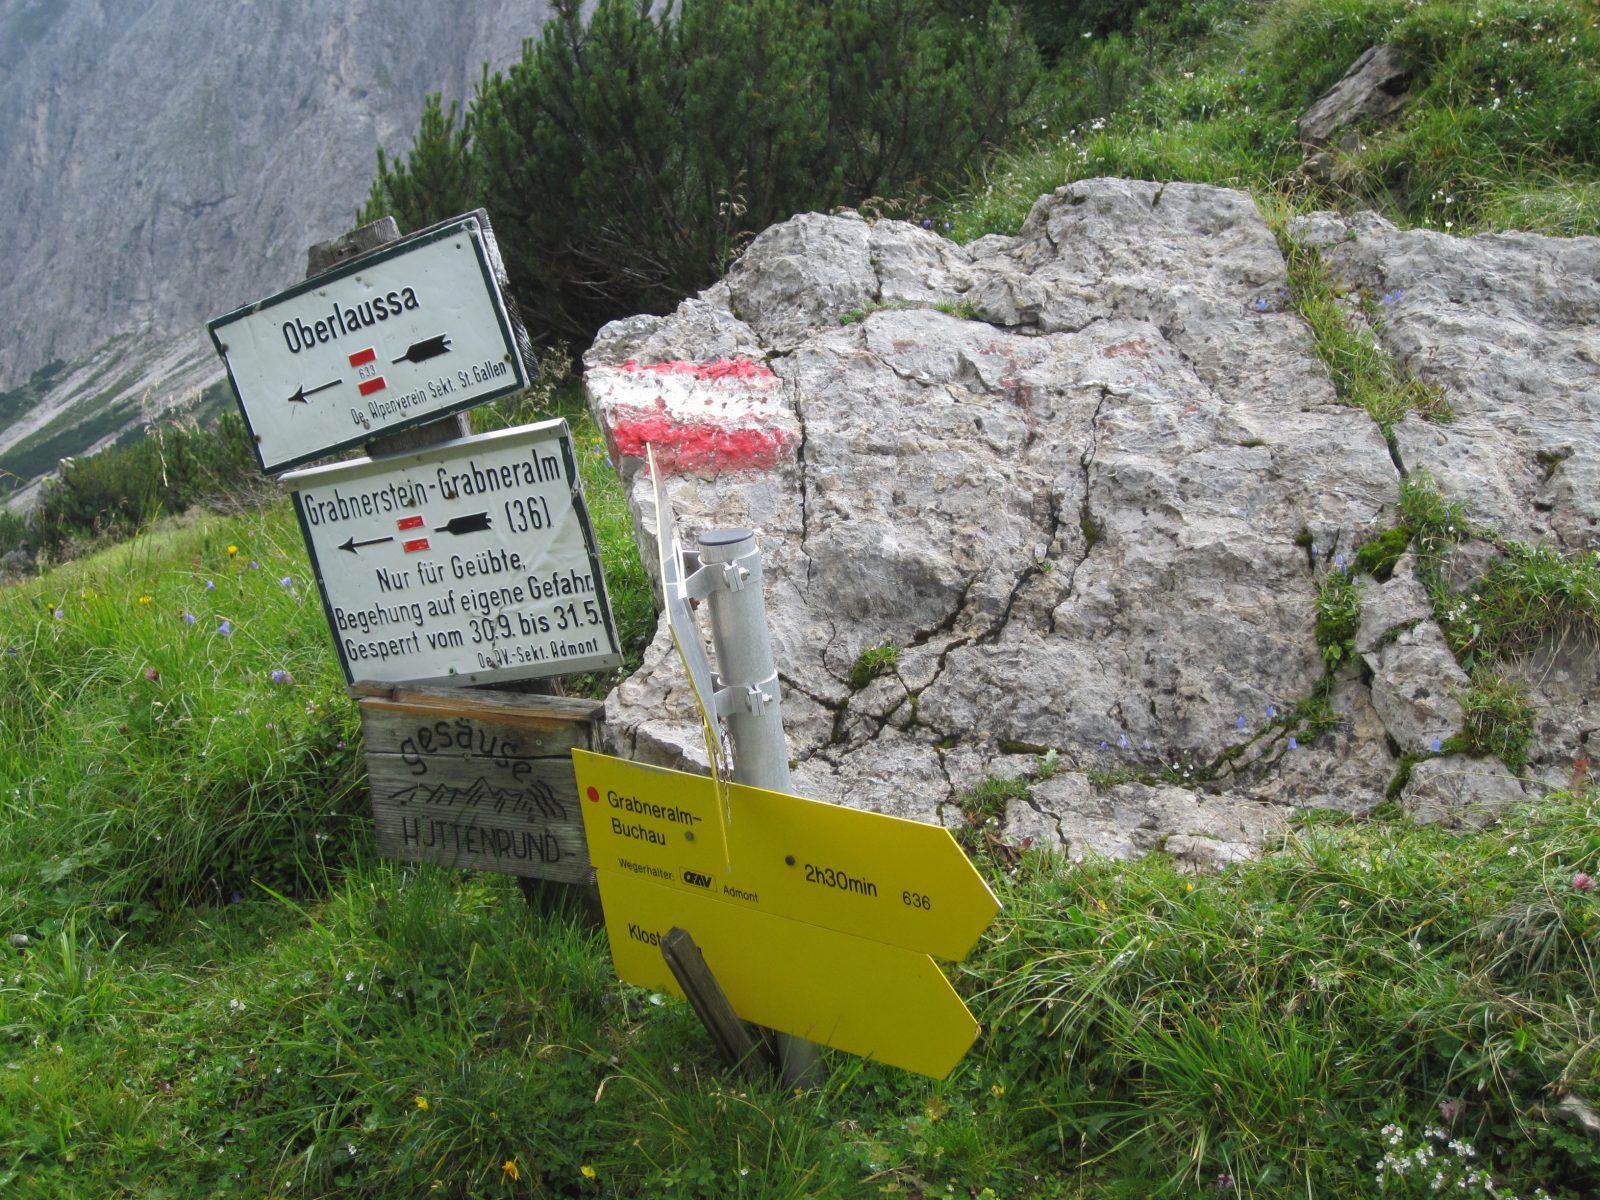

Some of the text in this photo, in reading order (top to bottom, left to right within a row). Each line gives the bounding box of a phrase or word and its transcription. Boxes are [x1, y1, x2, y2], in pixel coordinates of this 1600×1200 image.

[282, 285, 420, 354] Oberlaussa
[351, 359, 507, 425] Oe. Alpenverein Sekt. St. Gallen
[358, 363, 376, 377] 633
[505, 495, 552, 534] (36)
[376, 551, 526, 592] Nur für Geübte,
[334, 568, 594, 634] Begehung auf eigene Gefahr.
[345, 631, 420, 662] Gesperrt
[427, 628, 463, 651] vom
[519, 612, 550, 636] bis
[551, 638, 599, 658] Admont
[606, 790, 931, 911] Grabneralm- 2h30min 636
[611, 818, 666, 846] Buchau
[618, 858, 675, 881] Wegerhalter:
[723, 885, 759, 903] Admont
